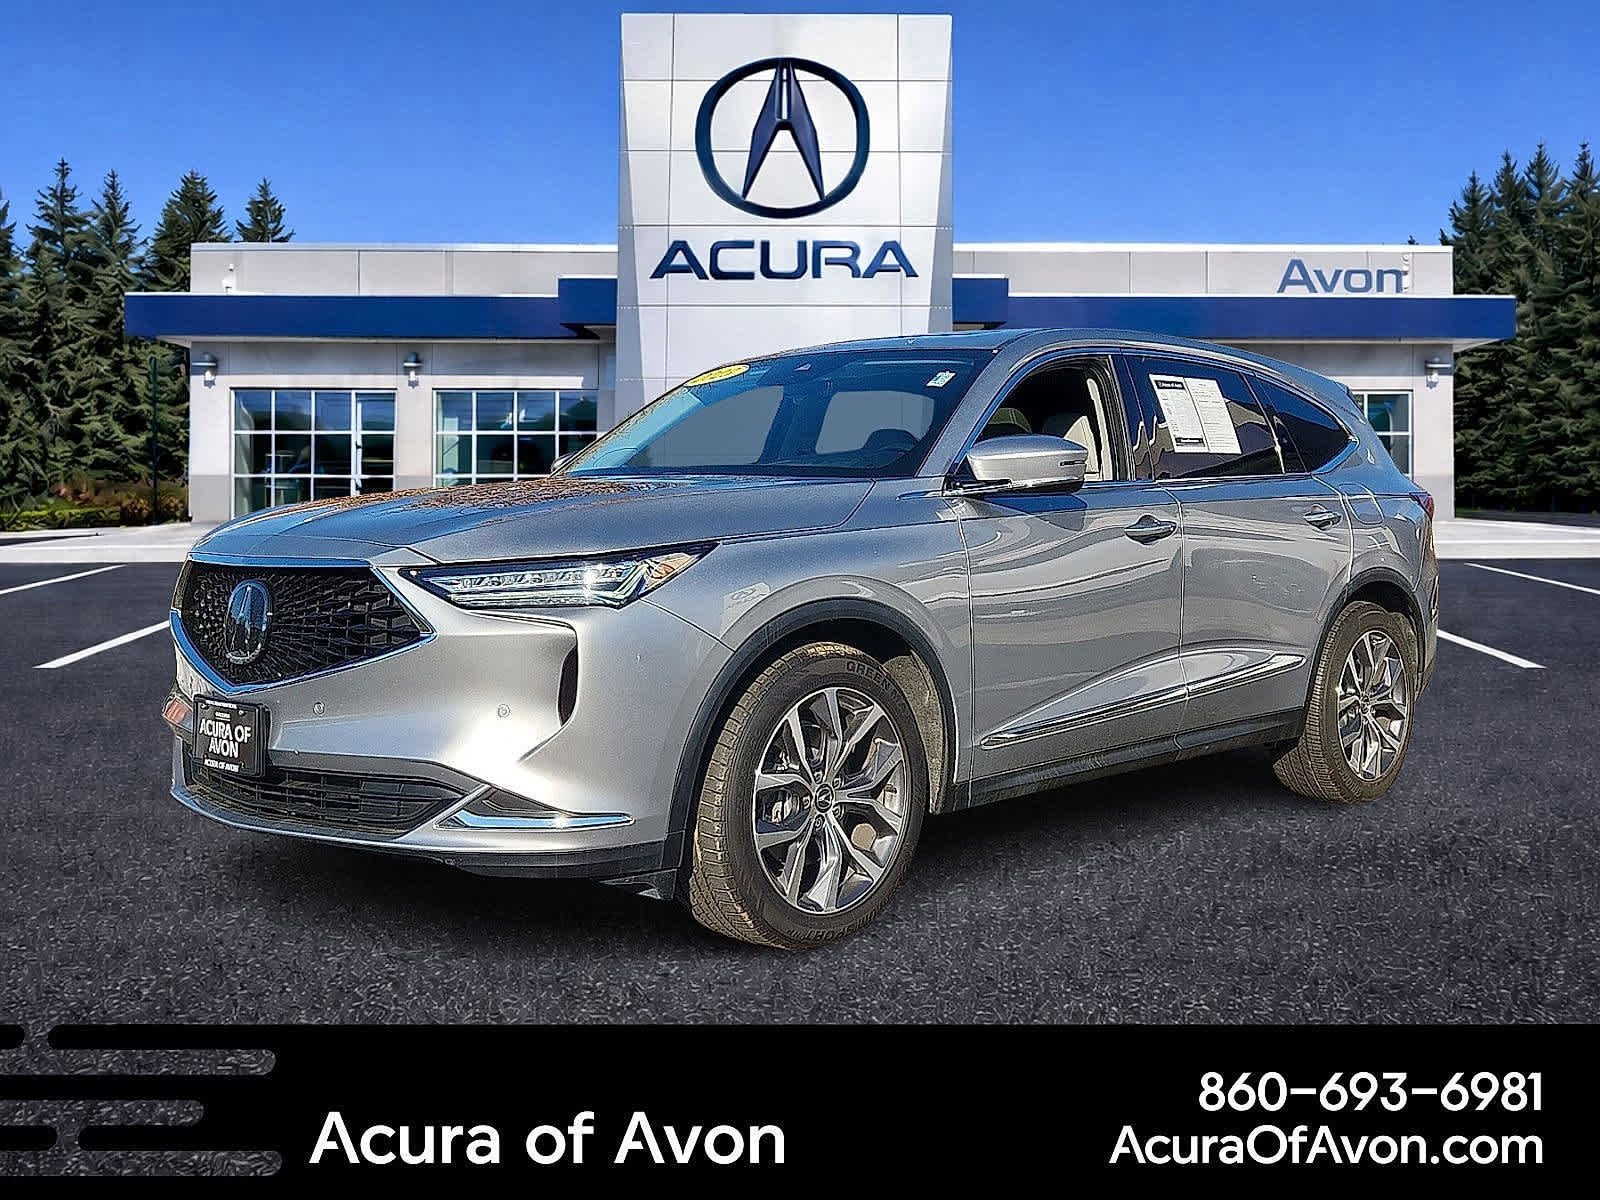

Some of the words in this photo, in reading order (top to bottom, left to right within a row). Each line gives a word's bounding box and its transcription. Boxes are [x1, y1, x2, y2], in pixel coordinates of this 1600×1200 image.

[649, 240, 920, 280] ACURA
[1277, 258, 1403, 294] Avon
[199, 718, 233, 741] ACURA
[234, 725, 252, 744] OF
[208, 737, 239, 759] AVON
